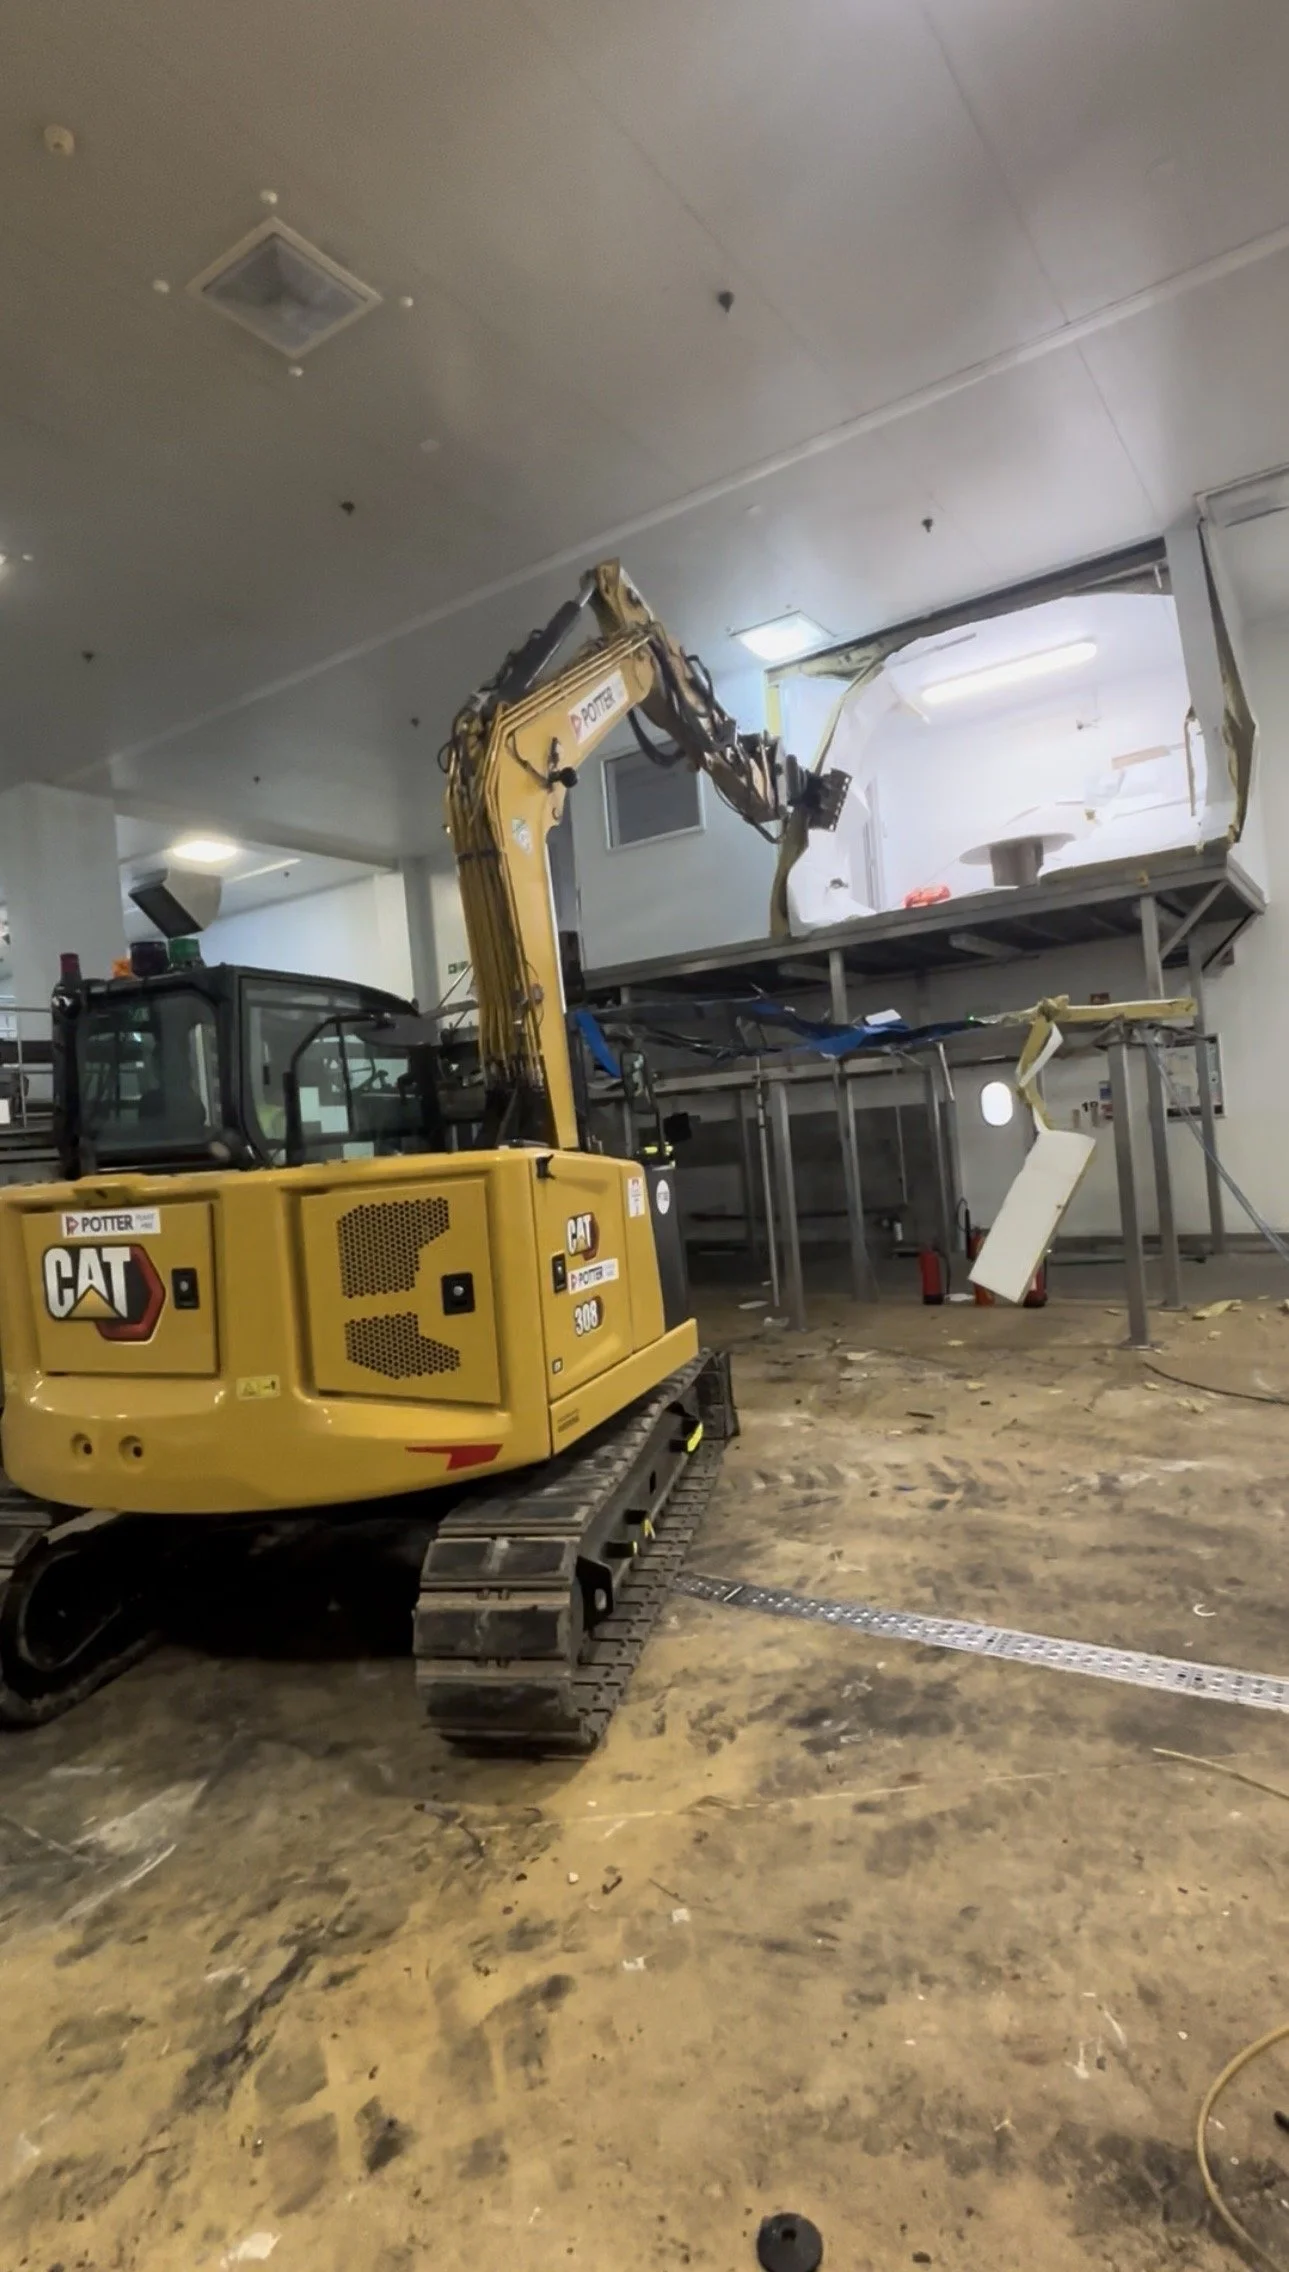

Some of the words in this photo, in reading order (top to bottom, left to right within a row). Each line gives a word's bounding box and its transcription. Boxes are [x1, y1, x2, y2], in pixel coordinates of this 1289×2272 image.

[581, 686, 616, 728] POTTER
[81, 1214, 134, 1232] POTTER
[567, 1213, 592, 1254] CAT
[44, 1246, 131, 1318] CAT
[575, 1299, 598, 1335] 308
